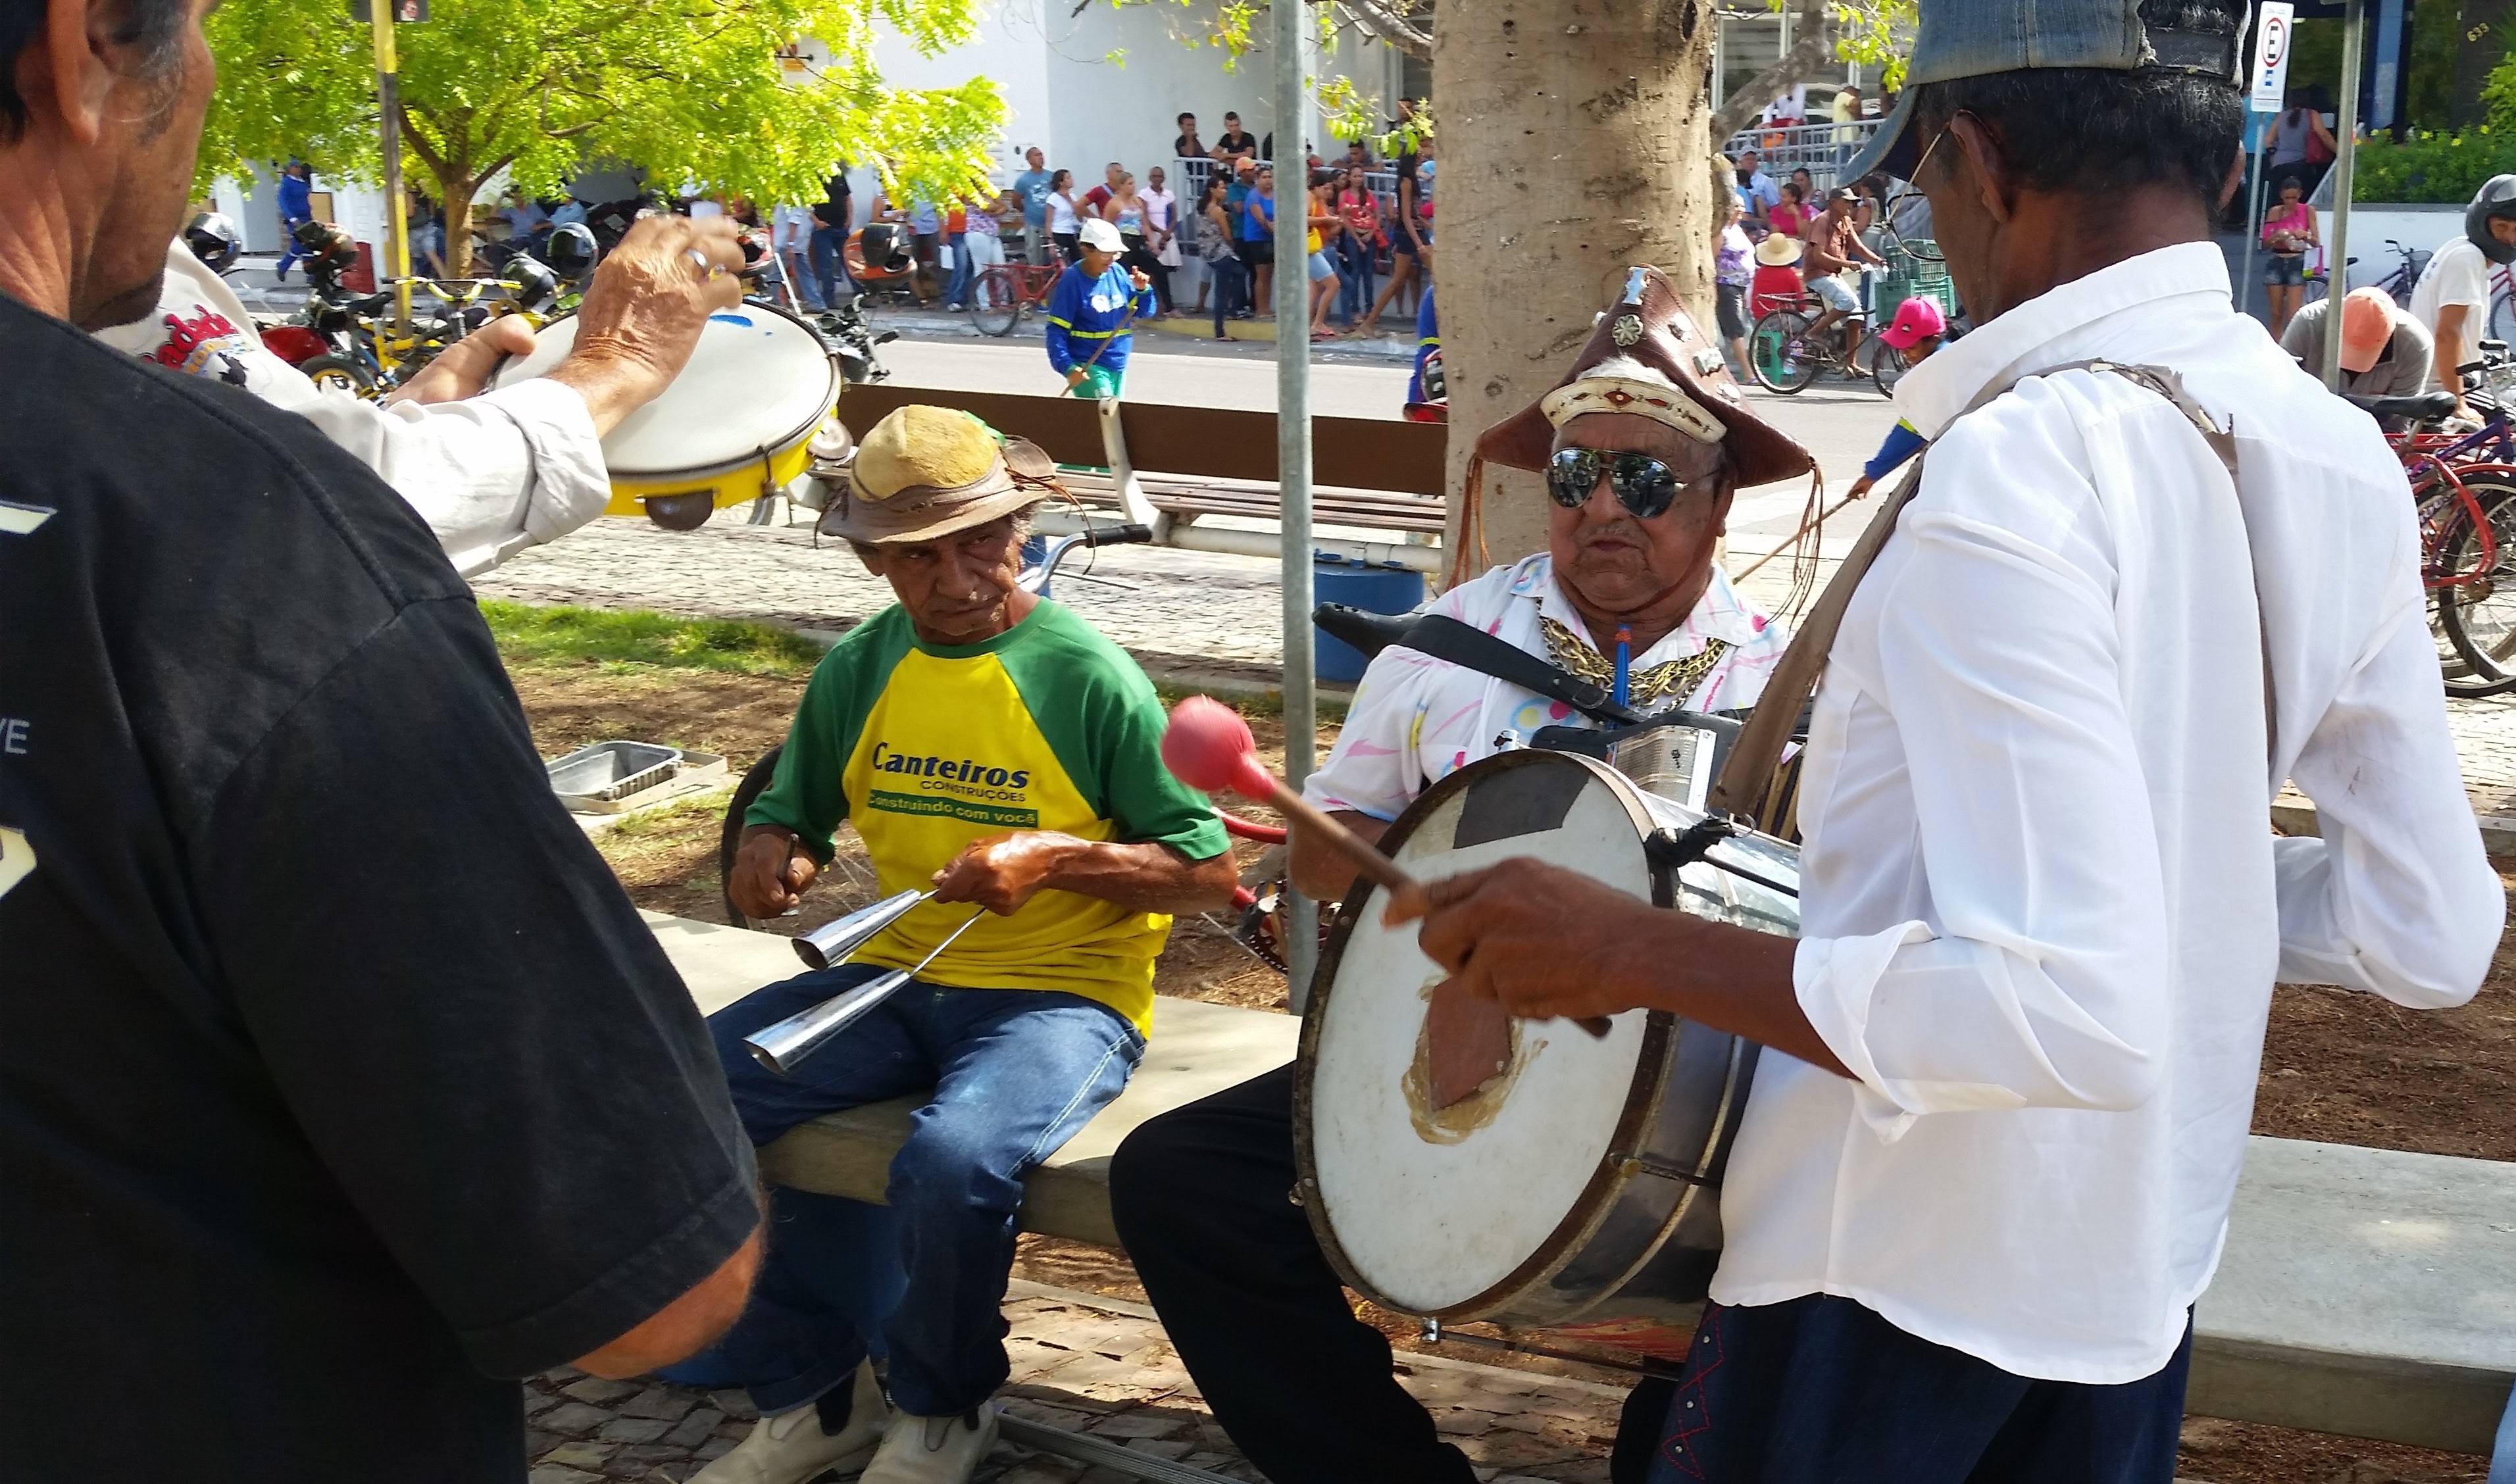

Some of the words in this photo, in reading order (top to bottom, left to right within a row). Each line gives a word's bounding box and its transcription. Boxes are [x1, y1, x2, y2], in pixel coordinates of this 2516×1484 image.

[872, 741, 1030, 789] Canteiros
[920, 780, 1026, 802] CONSTRUÇÕES
[955, 806, 990, 820] com
[994, 812, 1036, 824] você
